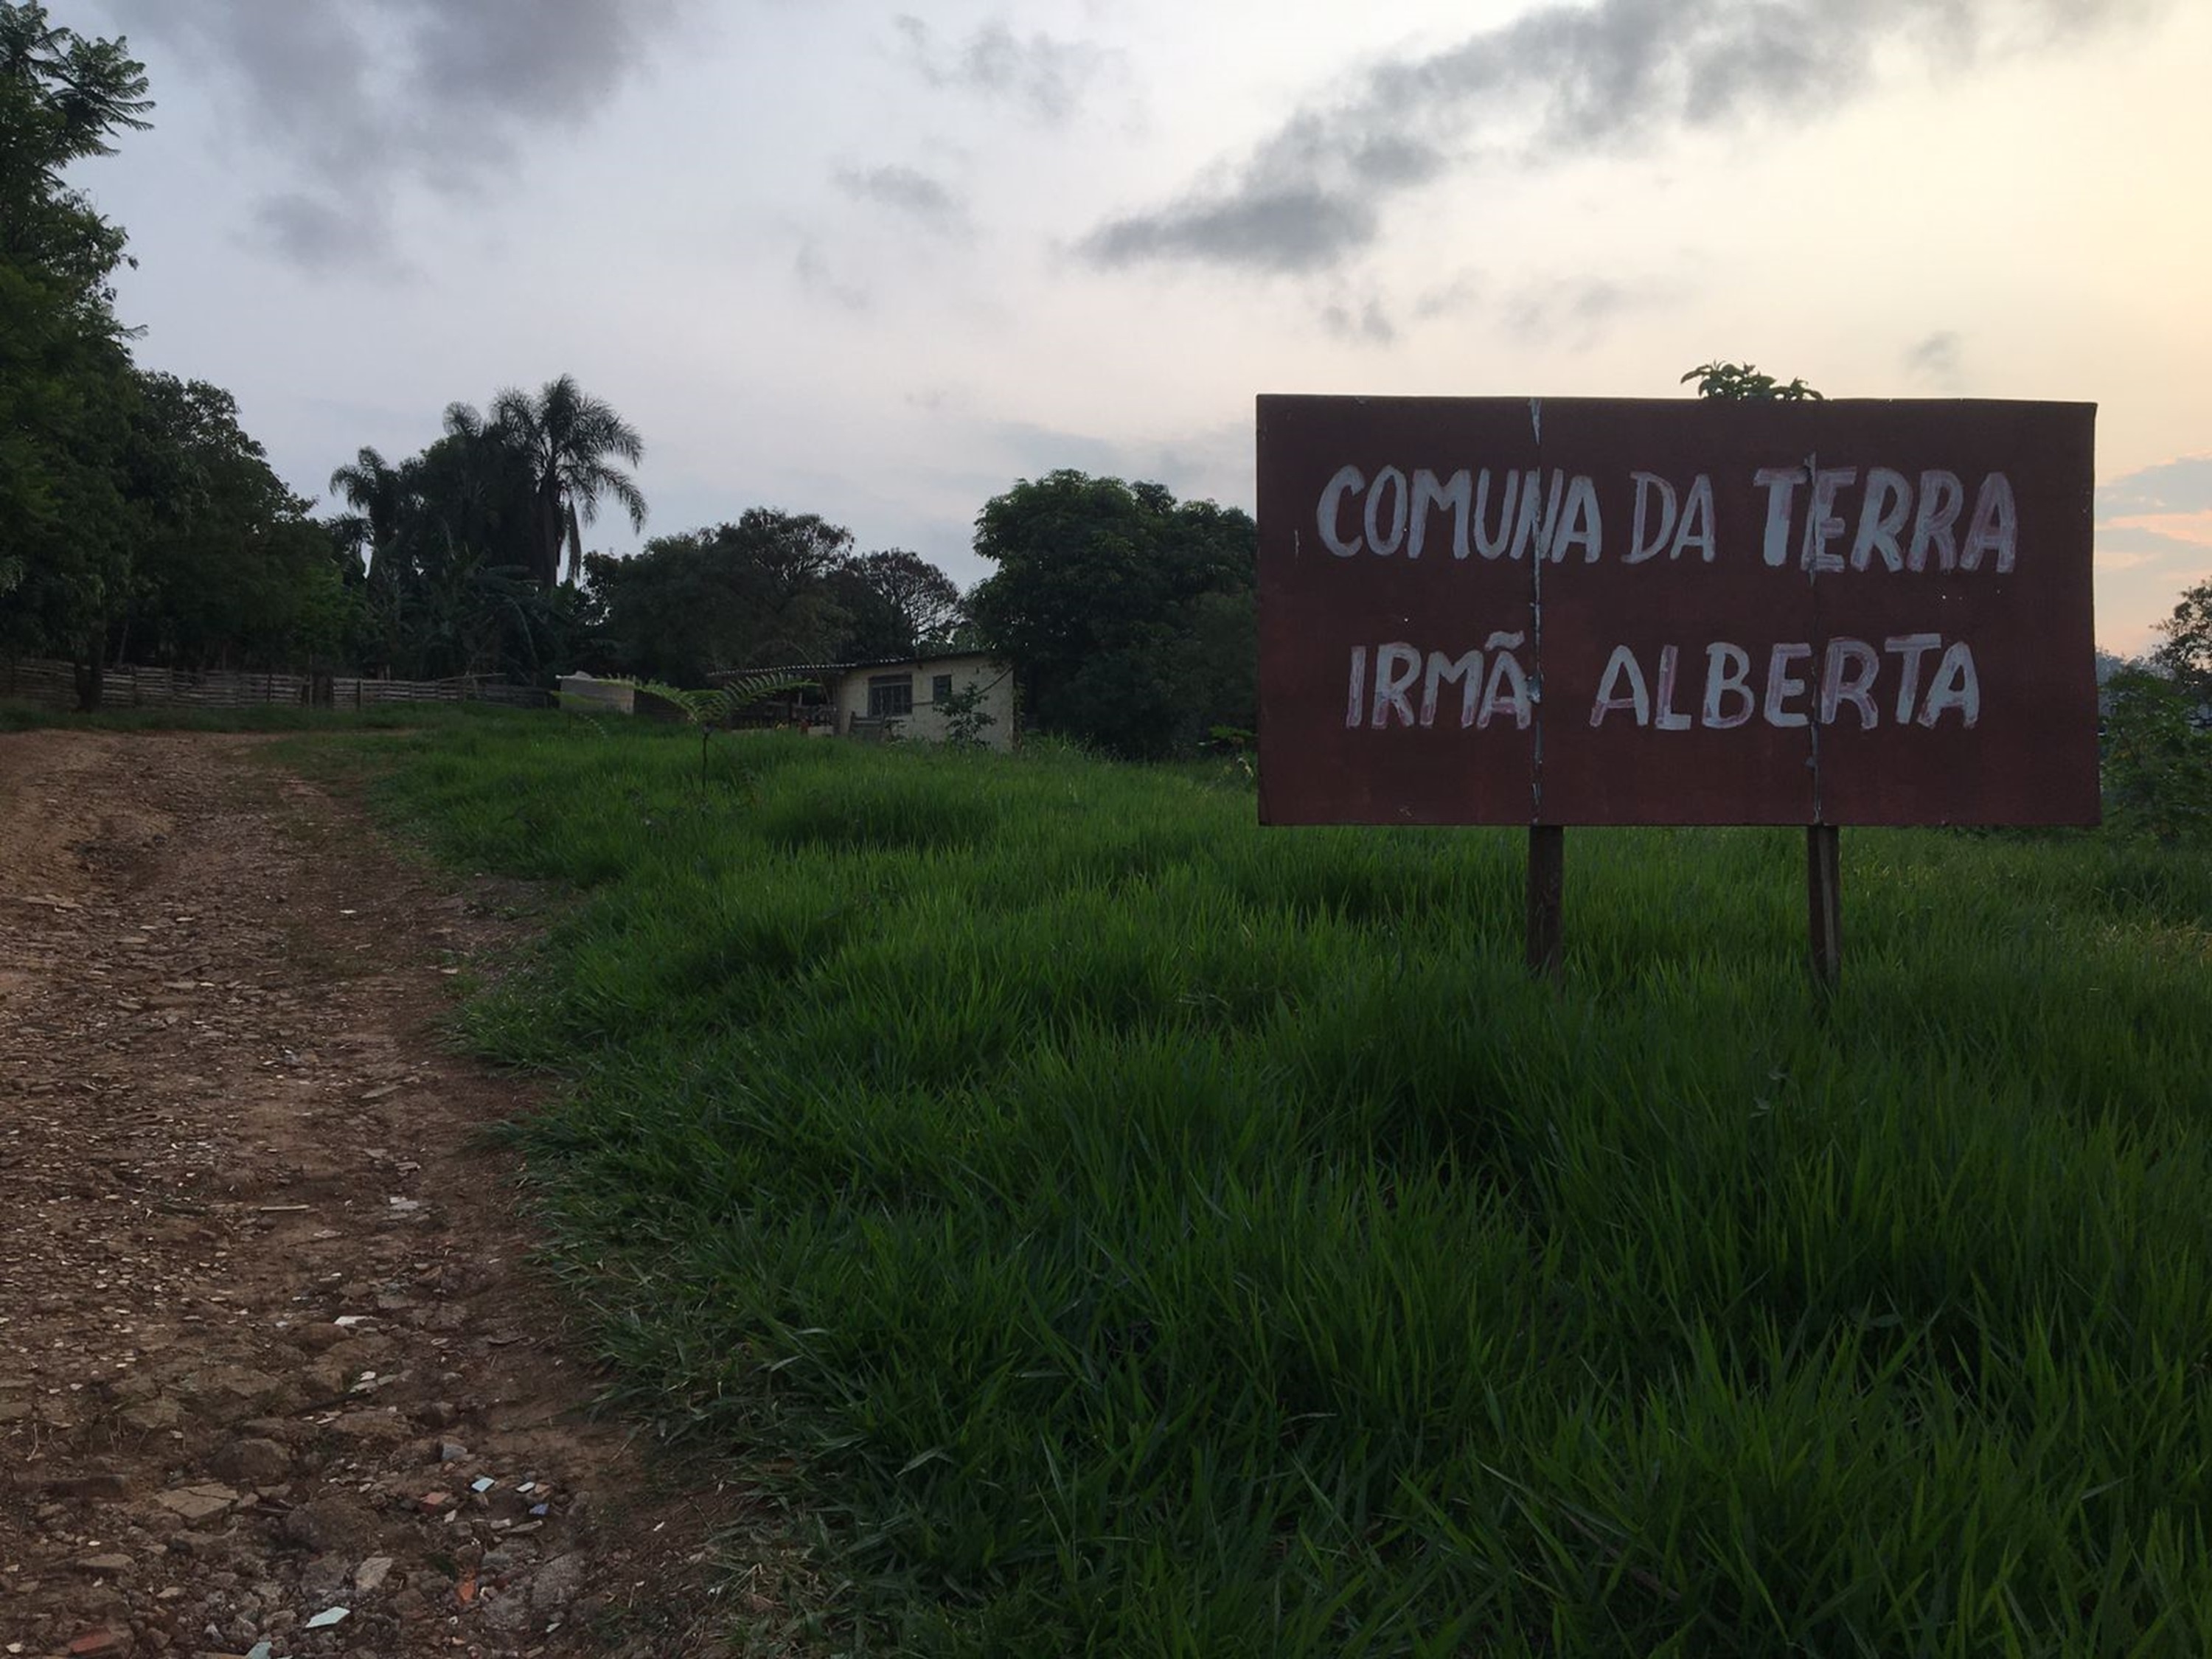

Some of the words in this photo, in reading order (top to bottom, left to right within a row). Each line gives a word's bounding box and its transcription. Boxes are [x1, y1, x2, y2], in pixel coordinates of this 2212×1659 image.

[1315, 465, 1602, 564] COMUNA
[1620, 470, 1716, 564] DA
[1753, 465, 2017, 574] TERRA
[1346, 630, 1532, 730] IRMÃ
[1590, 632, 1981, 731] ALBERTA
